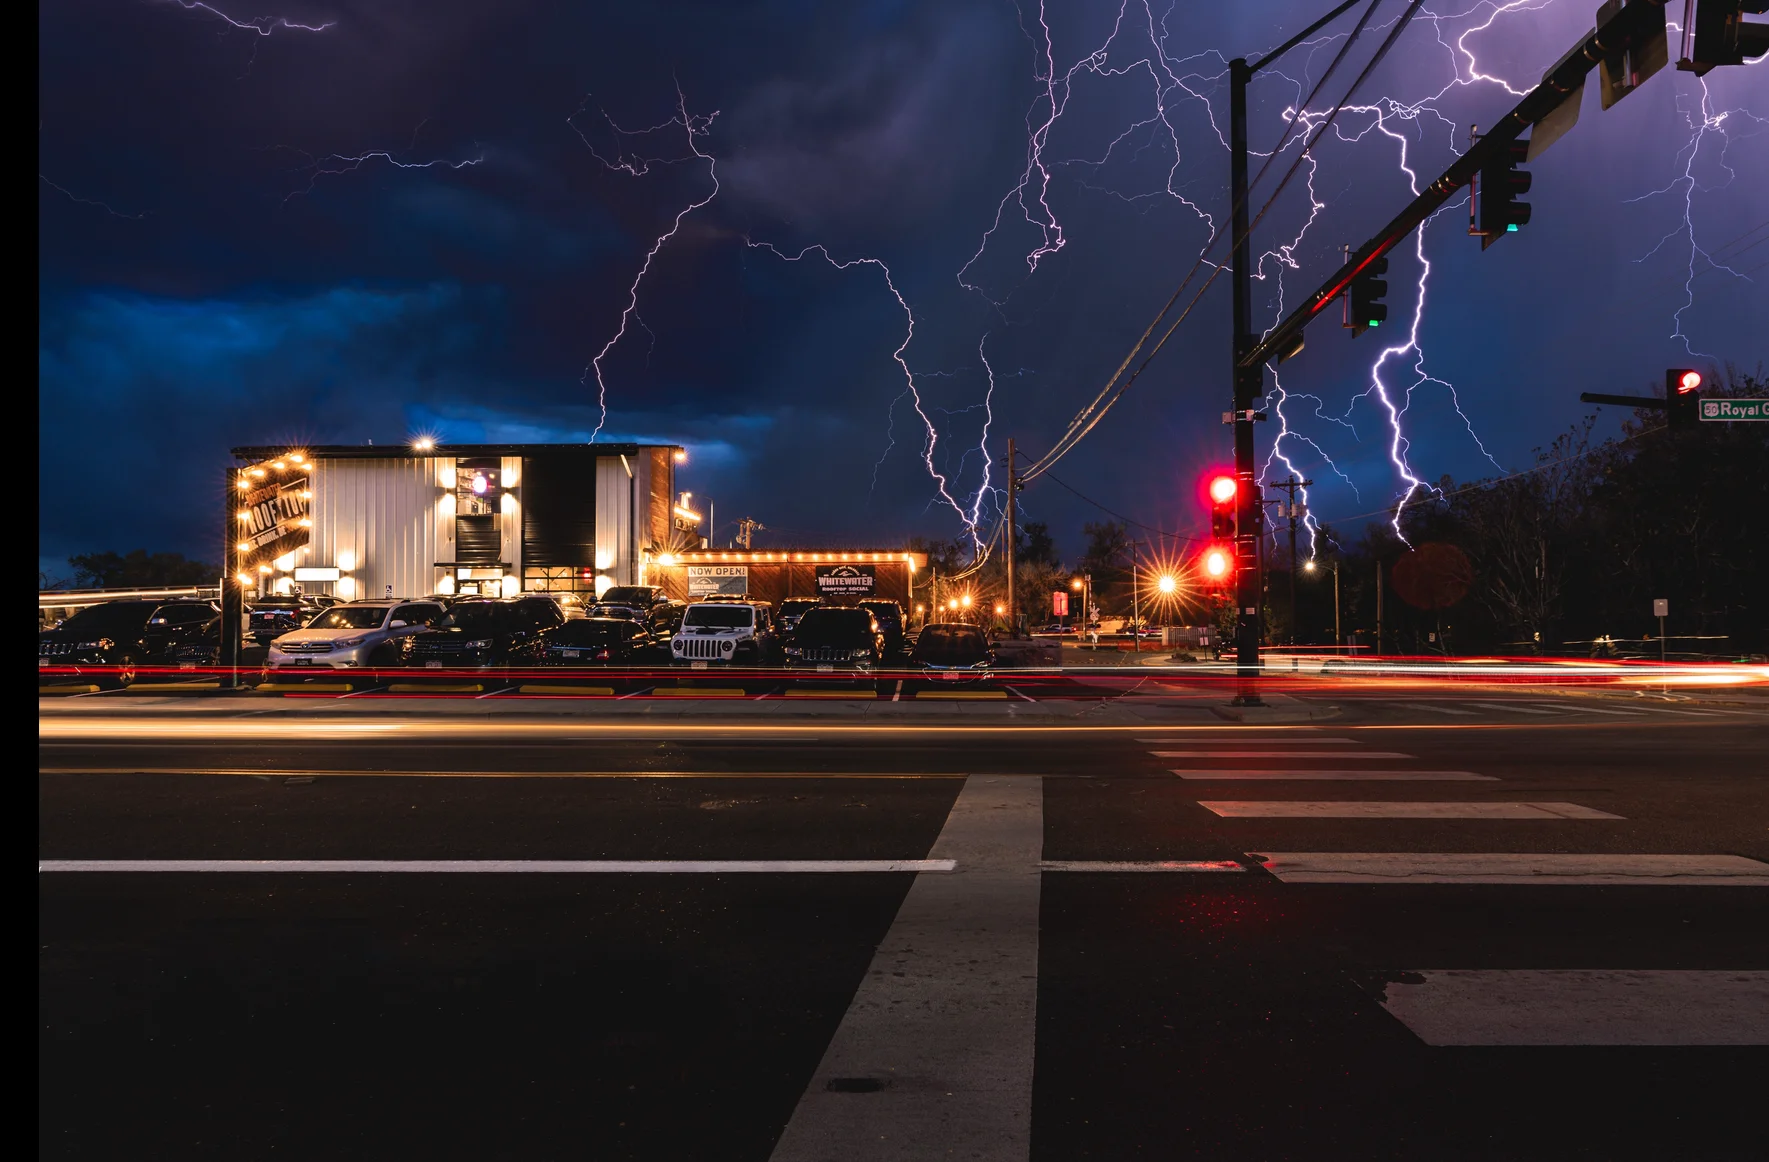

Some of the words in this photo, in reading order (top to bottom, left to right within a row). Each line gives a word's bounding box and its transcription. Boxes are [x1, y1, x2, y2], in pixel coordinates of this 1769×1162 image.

[1705, 405, 1717, 414] 50
[1720, 402, 1759, 418] Royal
[689, 567, 713, 576] NOW
[715, 567, 745, 576] OPEN!
[818, 576, 873, 587] WHITEWATER
